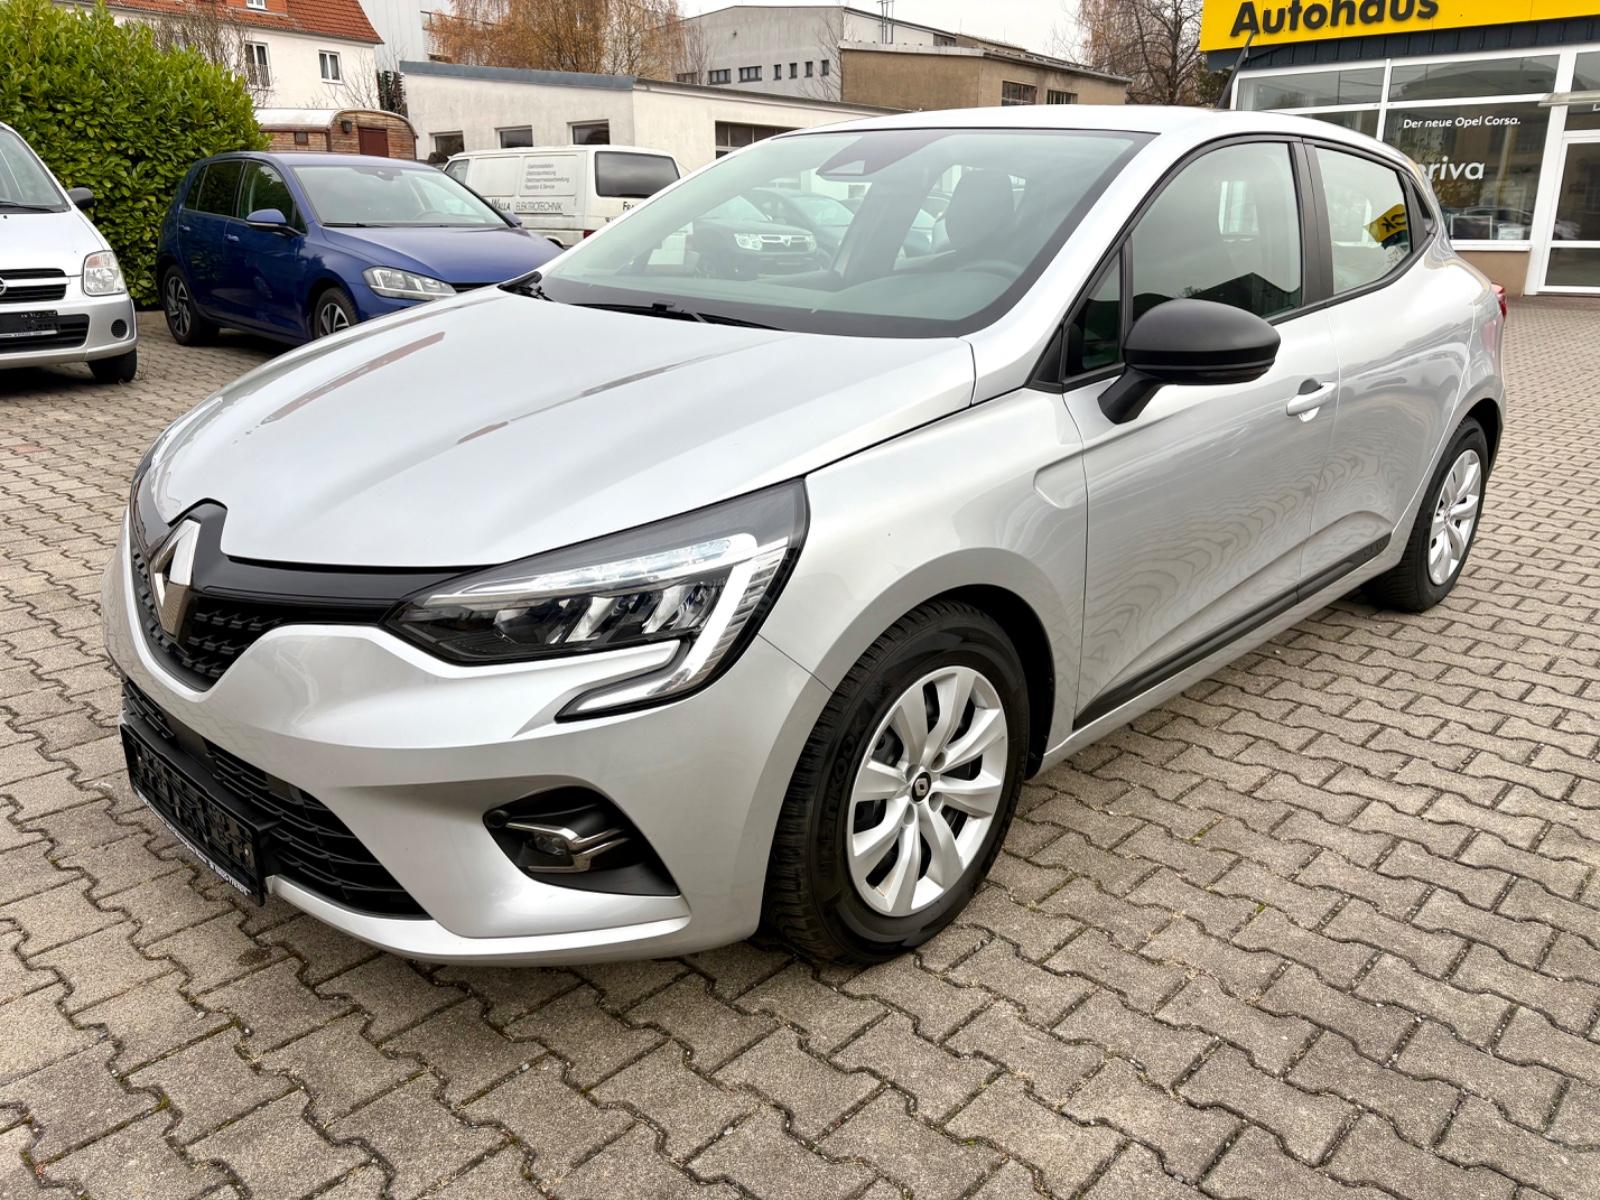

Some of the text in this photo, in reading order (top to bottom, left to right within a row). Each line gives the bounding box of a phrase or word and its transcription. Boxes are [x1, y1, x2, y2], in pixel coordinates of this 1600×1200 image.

[1229, 0, 1439, 37] Autohaus
[1403, 116, 1521, 128] Der neue Opel Corsa.
